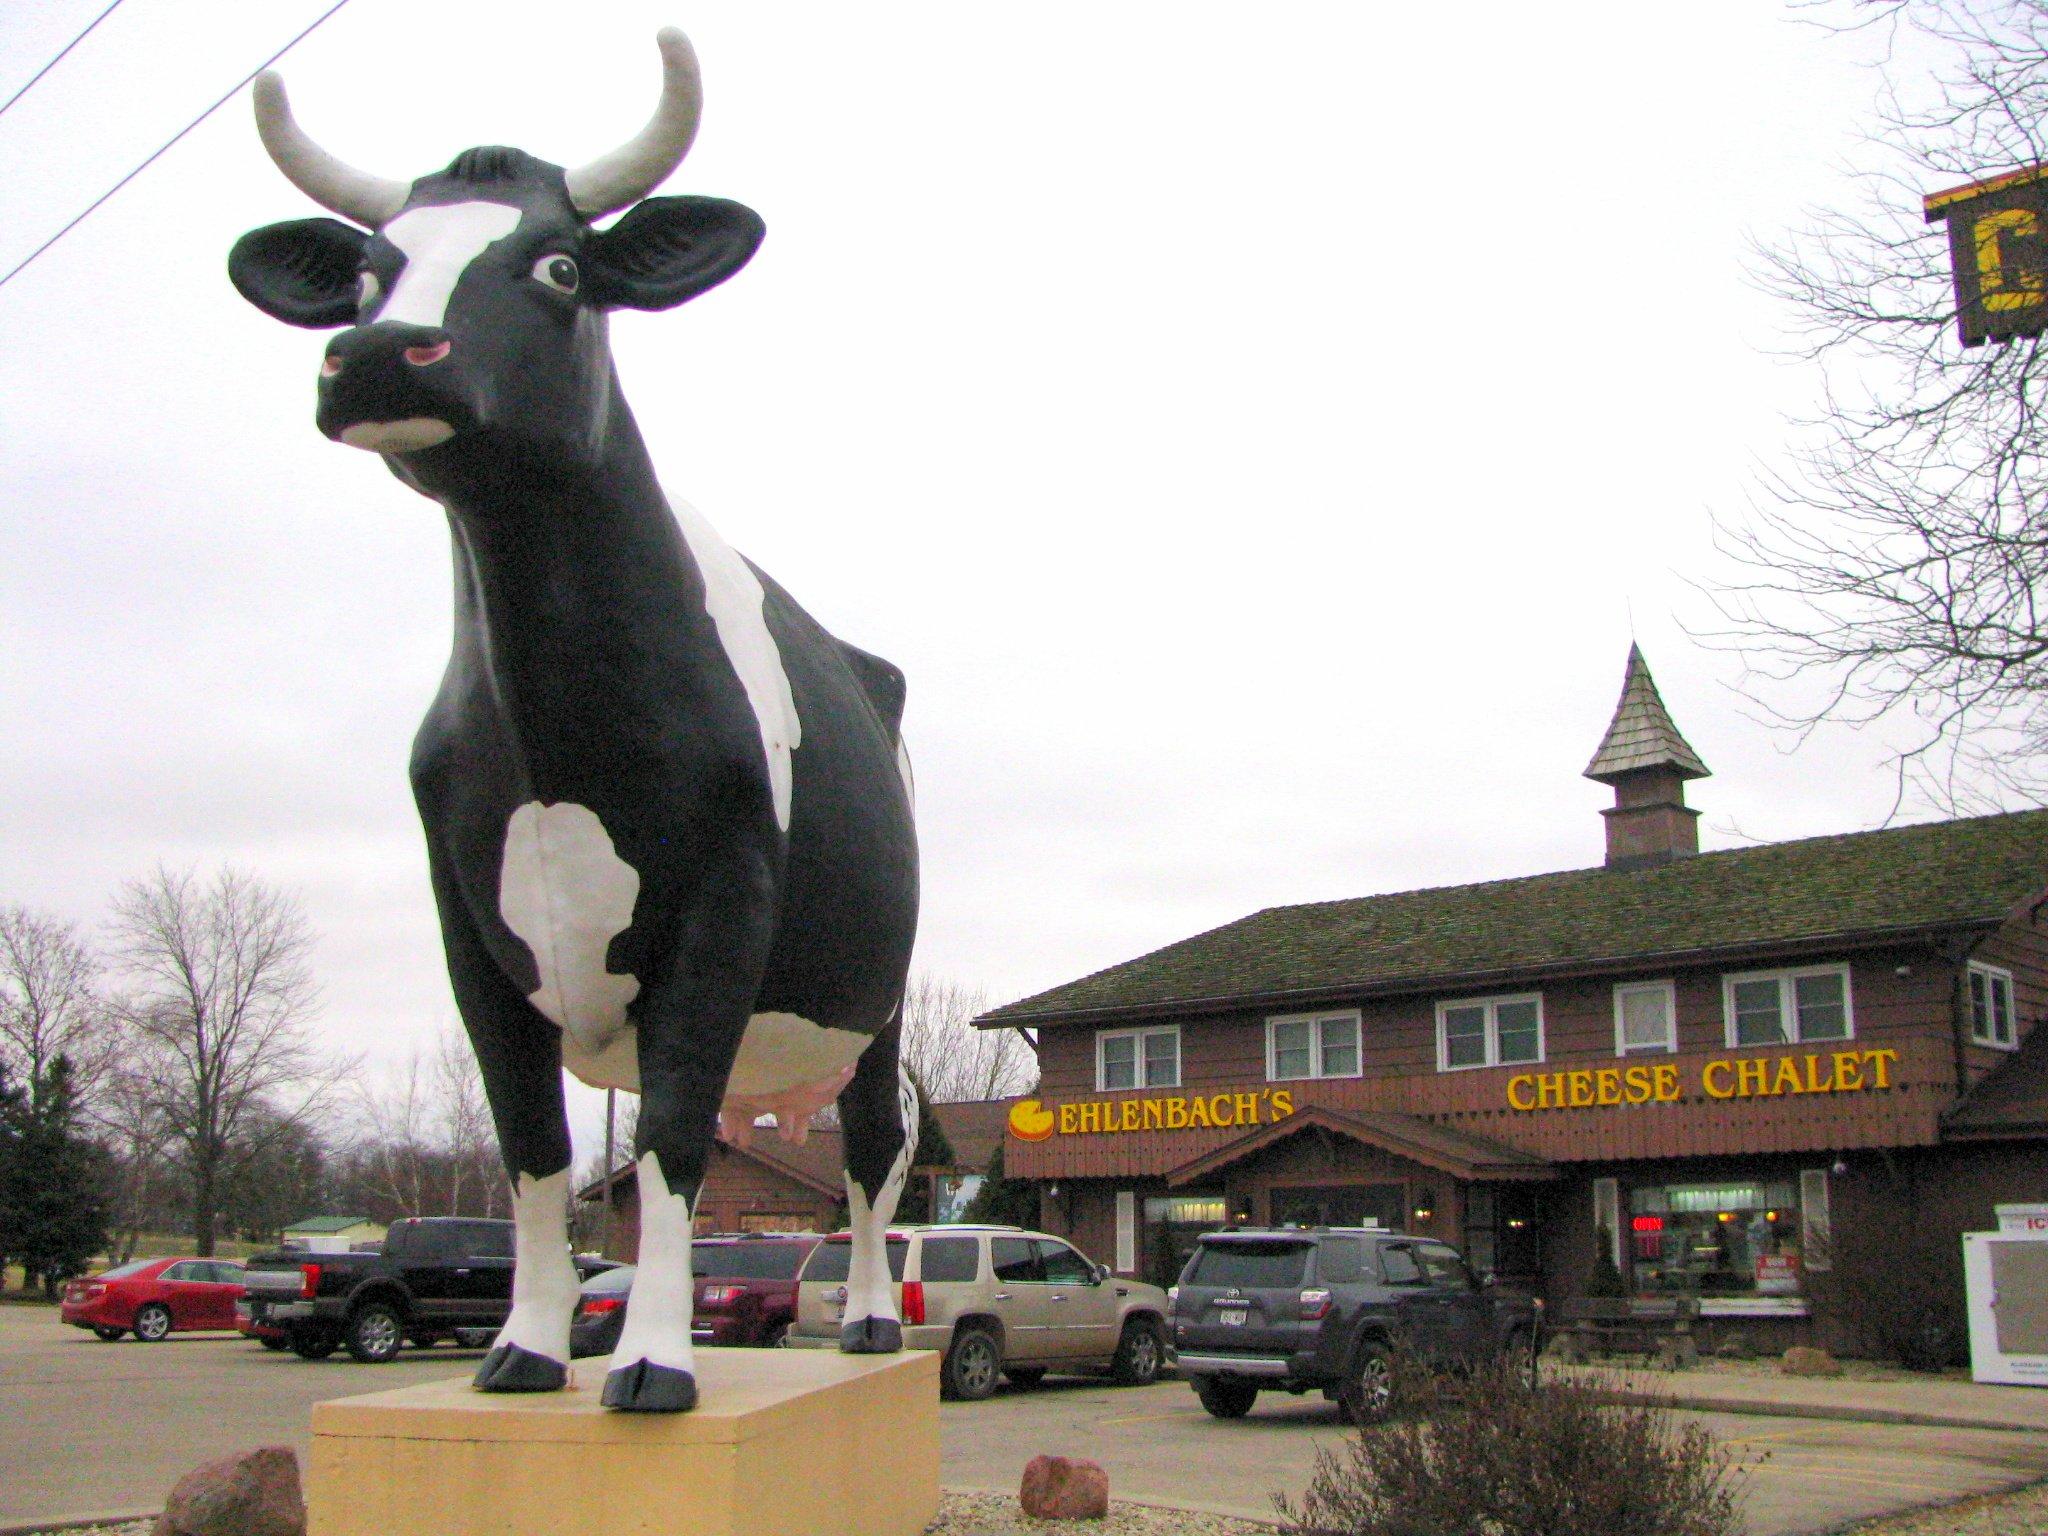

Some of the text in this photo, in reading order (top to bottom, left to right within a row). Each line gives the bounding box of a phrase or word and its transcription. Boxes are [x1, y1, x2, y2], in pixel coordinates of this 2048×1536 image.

[1507, 1048, 1899, 1112] CHEESE CHALET
[1058, 1088, 1295, 1136] EHLENBACH'S
[2027, 1217, 2048, 1230] IC
